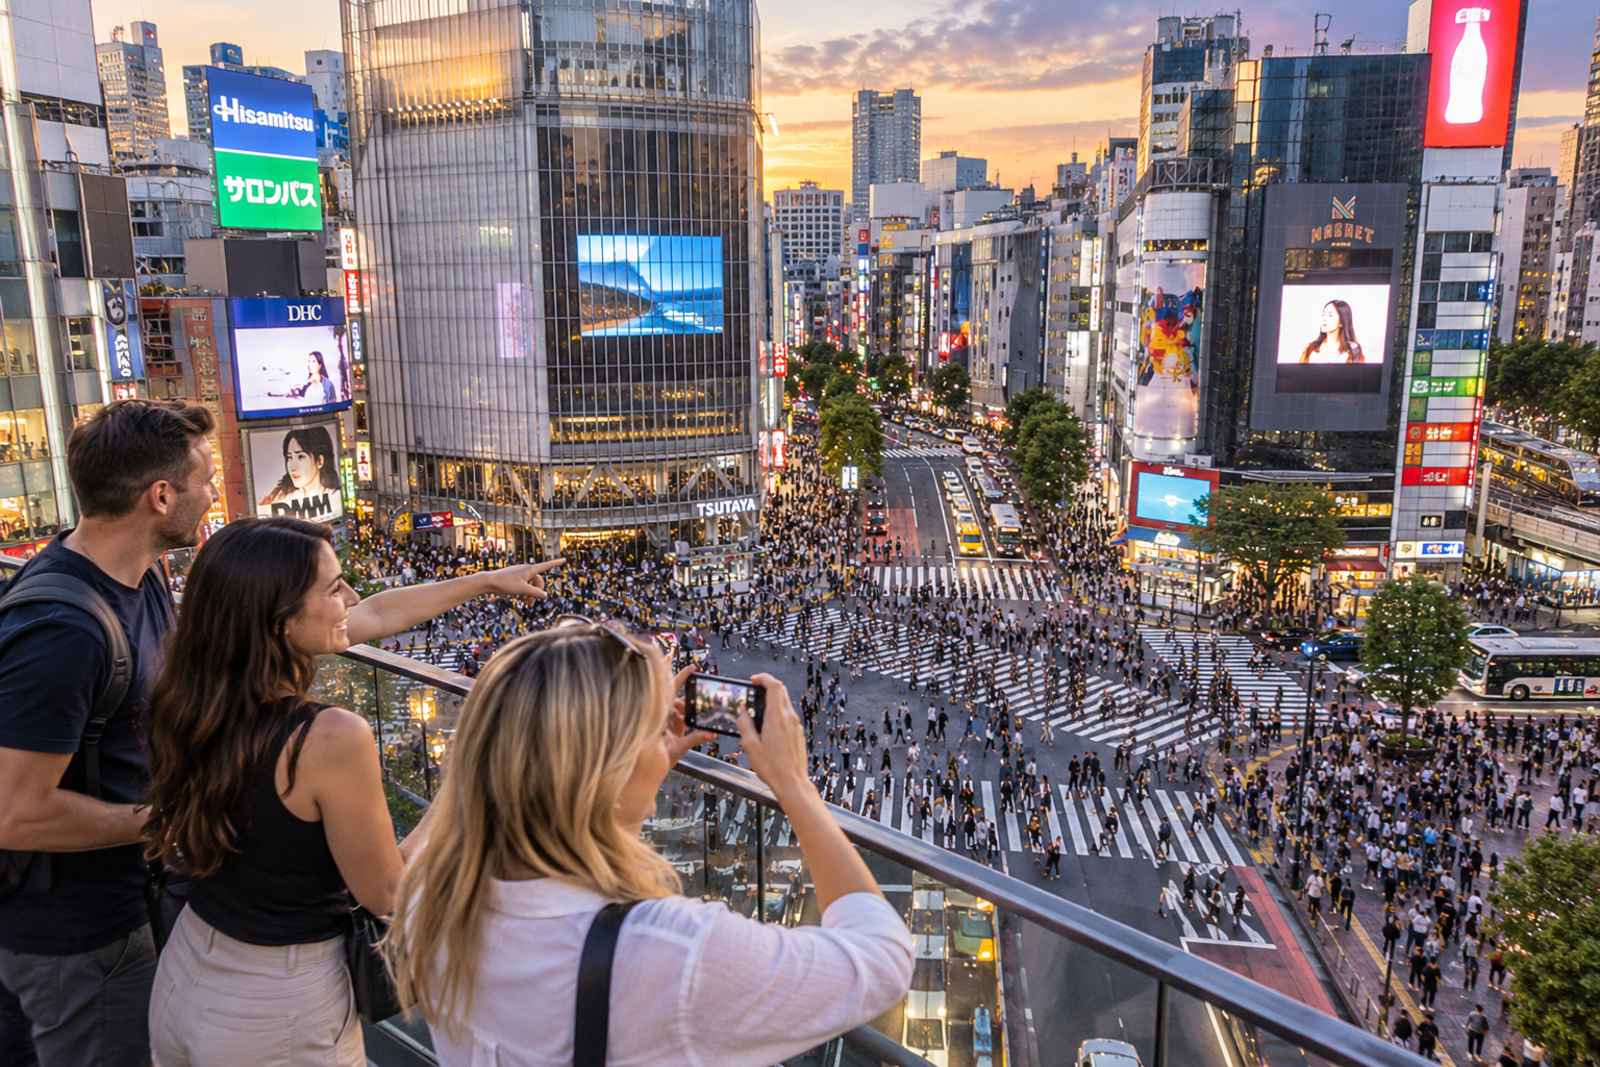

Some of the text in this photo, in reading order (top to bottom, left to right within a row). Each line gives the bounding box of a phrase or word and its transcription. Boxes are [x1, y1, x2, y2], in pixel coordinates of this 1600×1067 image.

[213, 95, 314, 132] Hisamitsu
[223, 175, 318, 207] サロンパス
[288, 305, 321, 321] DHC
[696, 498, 755, 517] TSUTAYA
